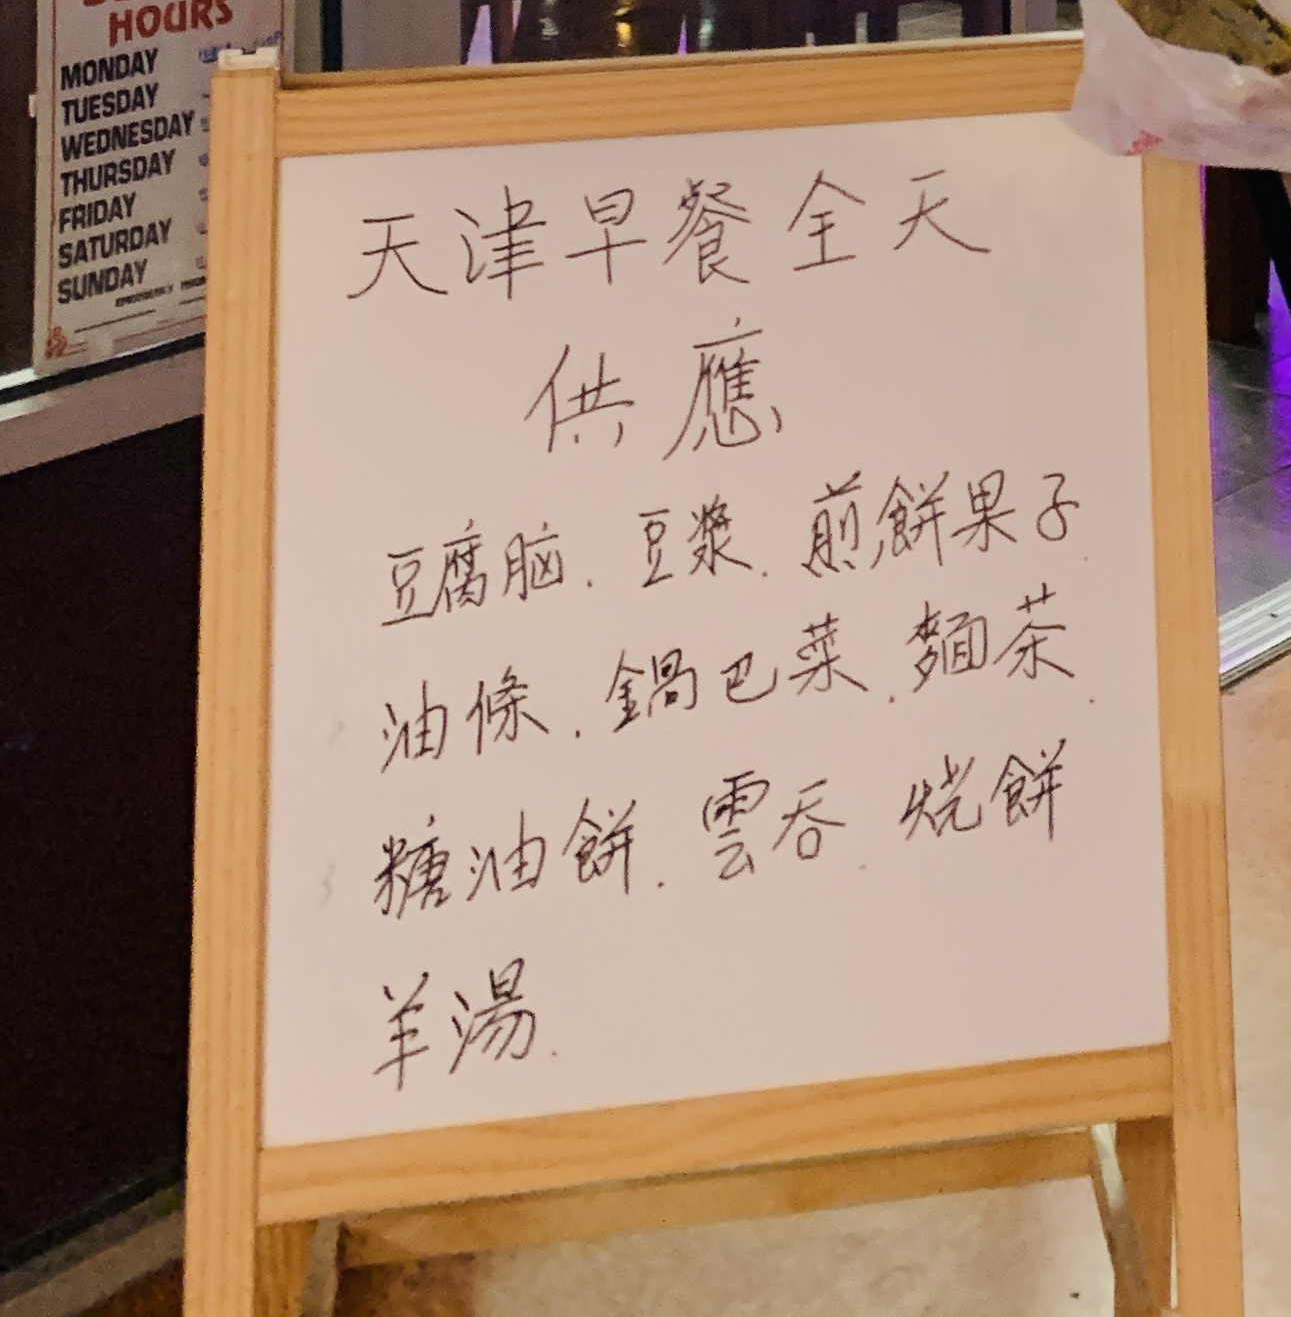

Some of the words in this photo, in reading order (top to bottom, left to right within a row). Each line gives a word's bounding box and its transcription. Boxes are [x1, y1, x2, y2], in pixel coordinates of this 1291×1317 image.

[60, 48, 159, 91] MONDAY
[61, 82, 159, 126] TUESDAY
[60, 110, 196, 163] WEDNESDAY
[60, 148, 176, 198] THURSDAY
[58, 191, 137, 234] FRIDAY
[347, 167, 991, 300] 天津早餐全天
[58, 217, 173, 270] SATURDAY
[57, 258, 148, 305] SUNDAY
